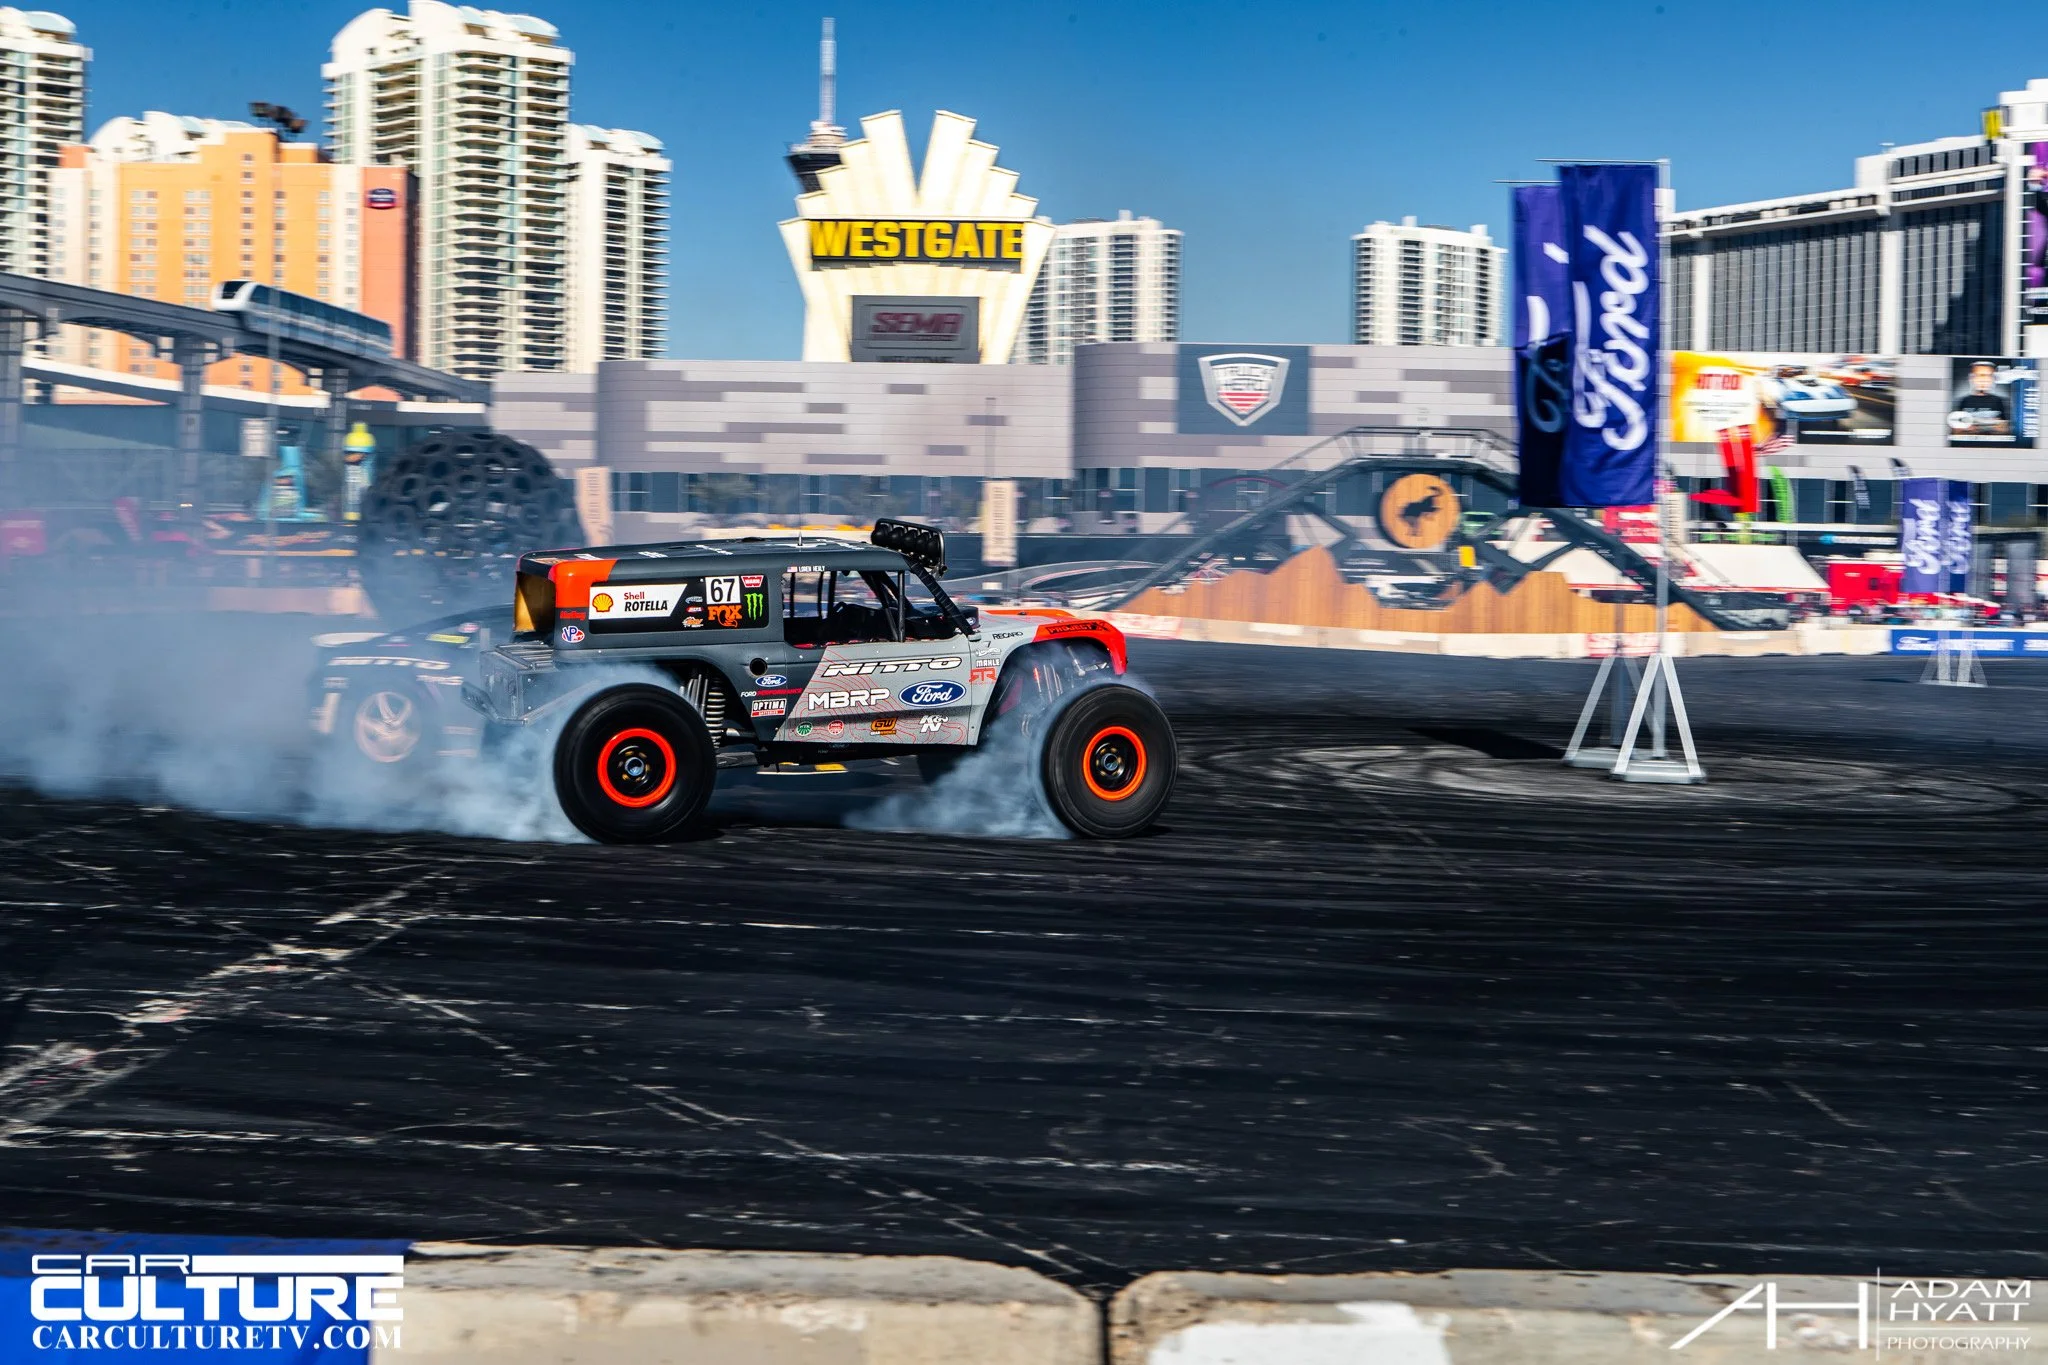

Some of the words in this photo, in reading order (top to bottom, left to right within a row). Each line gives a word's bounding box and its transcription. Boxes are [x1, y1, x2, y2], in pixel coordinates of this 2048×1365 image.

[811, 221, 1024, 258] WESTGATE
[871, 312, 964, 333] SEMA
[1572, 224, 1650, 451] Ford
[624, 592, 645, 600] Shell
[710, 578, 735, 602] 67
[624, 601, 668, 612] ROTELLA
[707, 605, 742, 622] FOX
[563, 626, 578, 641] VP
[992, 631, 1023, 640] RECARO
[1048, 624, 1091, 634] PROJECT
[821, 657, 963, 678] NITTO
[975, 659, 1000, 667] MAHLE
[760, 676, 782, 686] Ford
[808, 688, 890, 710] MBRP
[912, 684, 953, 703] Ford
[753, 700, 785, 711] OPTIMA
